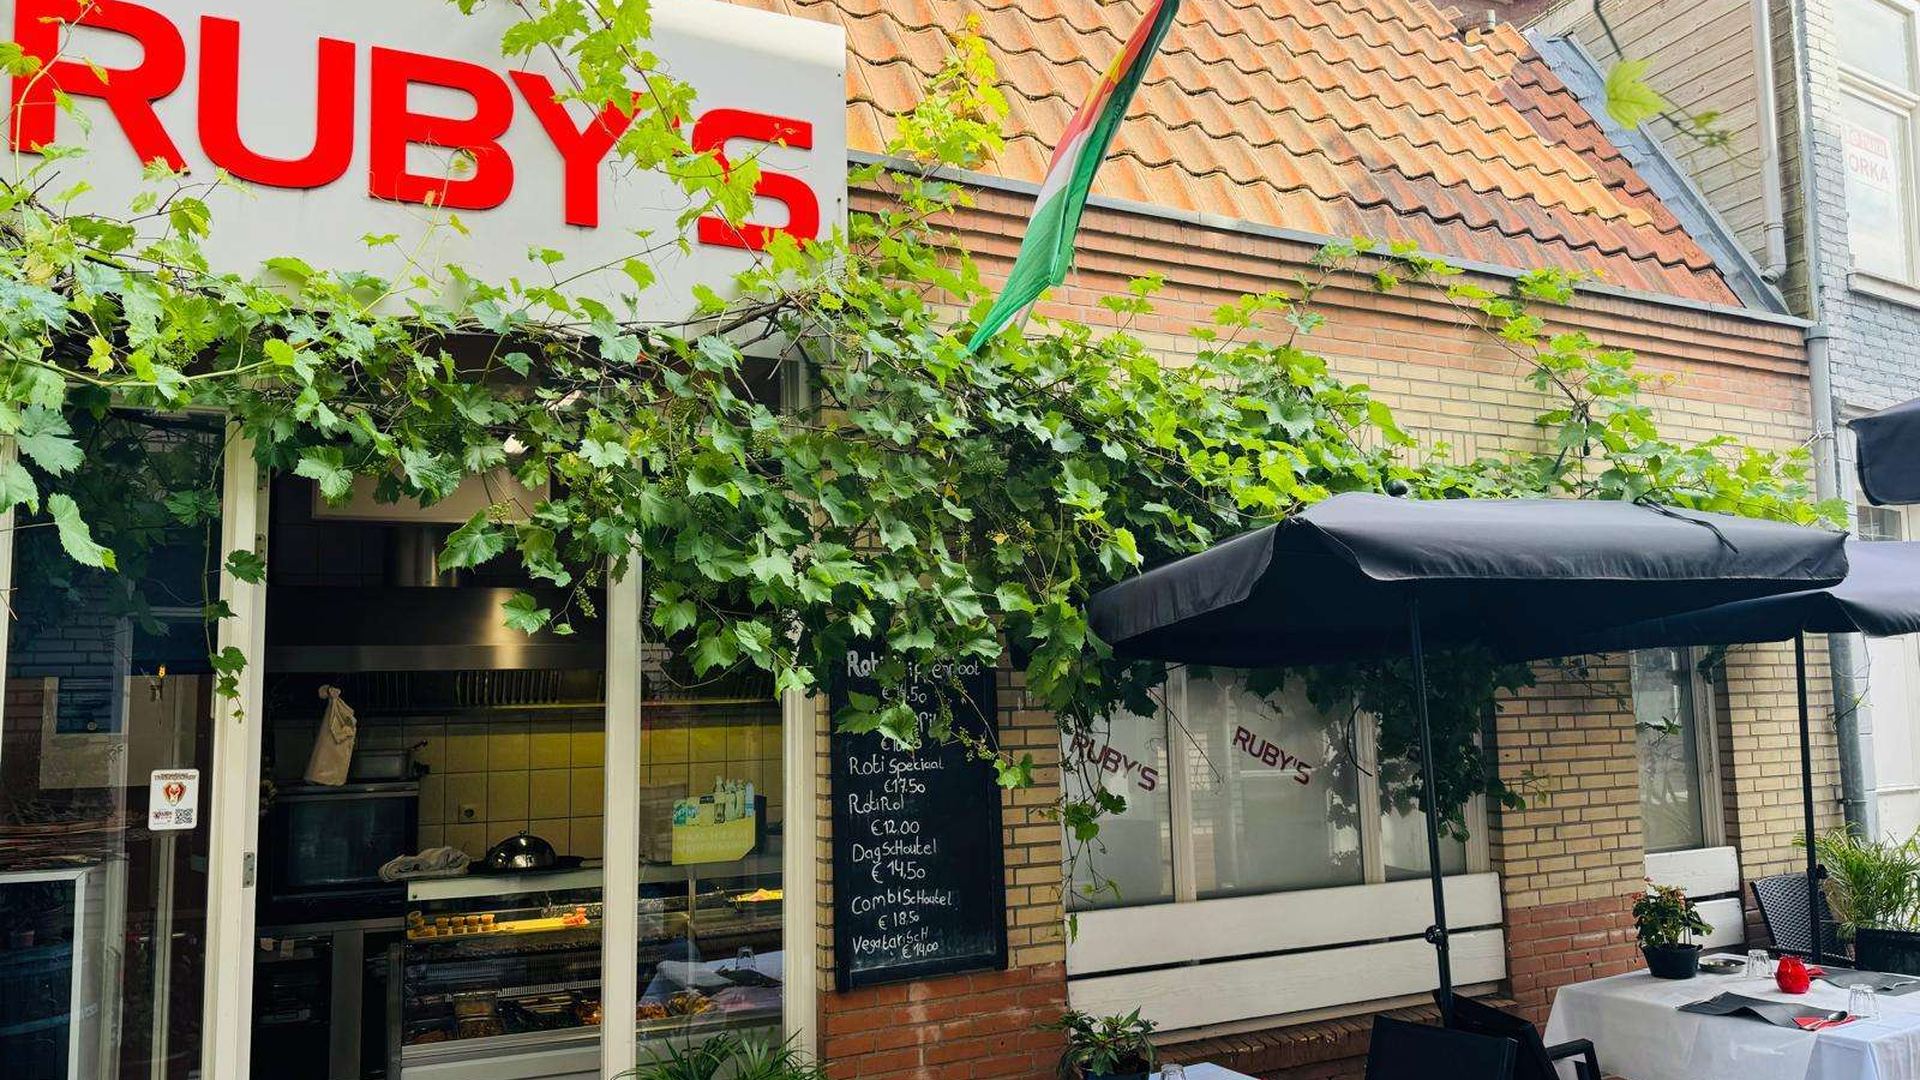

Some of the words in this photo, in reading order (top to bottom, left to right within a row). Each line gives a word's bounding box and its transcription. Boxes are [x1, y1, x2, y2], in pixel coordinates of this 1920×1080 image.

[10, 0, 819, 252] RUBYS
[849, 753, 884, 774] Roti
[1069, 732, 1159, 791] RUBY'S
[1231, 726, 1314, 785] RUBY'S
